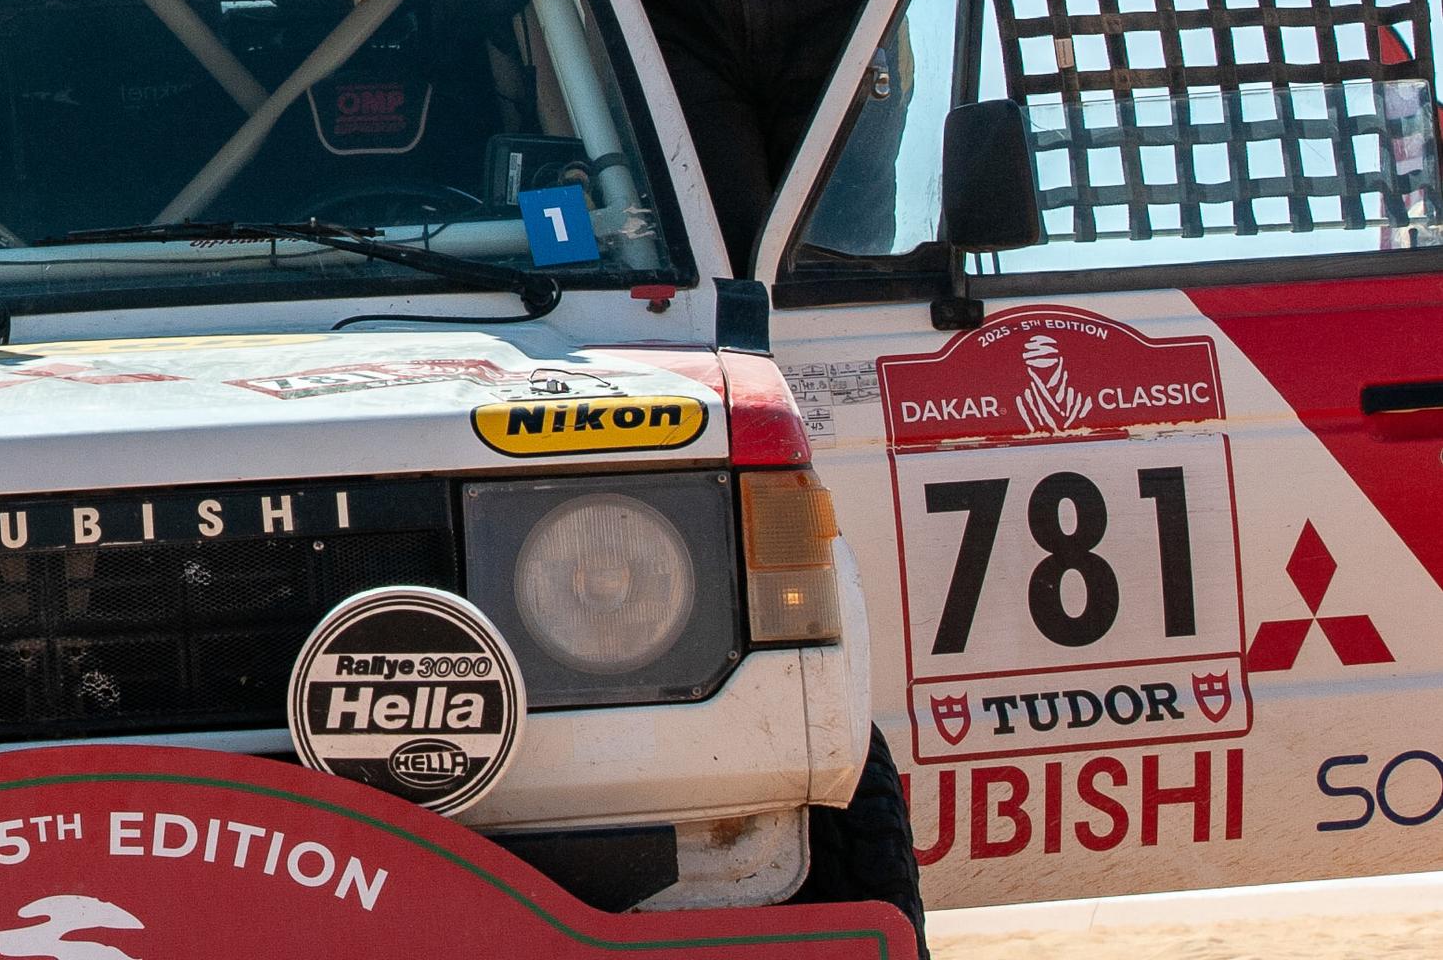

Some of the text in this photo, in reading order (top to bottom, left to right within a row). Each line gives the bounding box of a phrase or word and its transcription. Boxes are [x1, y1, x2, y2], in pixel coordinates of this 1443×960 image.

[544, 207, 569, 242] 1
[977, 325, 1009, 348] 2025
[1022, 319, 1041, 330] 5TH
[1044, 319, 1108, 340] EDITION
[506, 403, 683, 436] Nikon
[901, 382, 1210, 423] DAKAR CLASSIC
[924, 466, 1196, 655] 781
[336, 655, 493, 680] Rallye 3000
[326, 687, 486, 730] Hella
[983, 682, 1185, 736] TUDOR
[395, 750, 467, 774] HELLA
[900, 748, 1244, 866] UBISHI
[109, 811, 389, 912] EDITION
